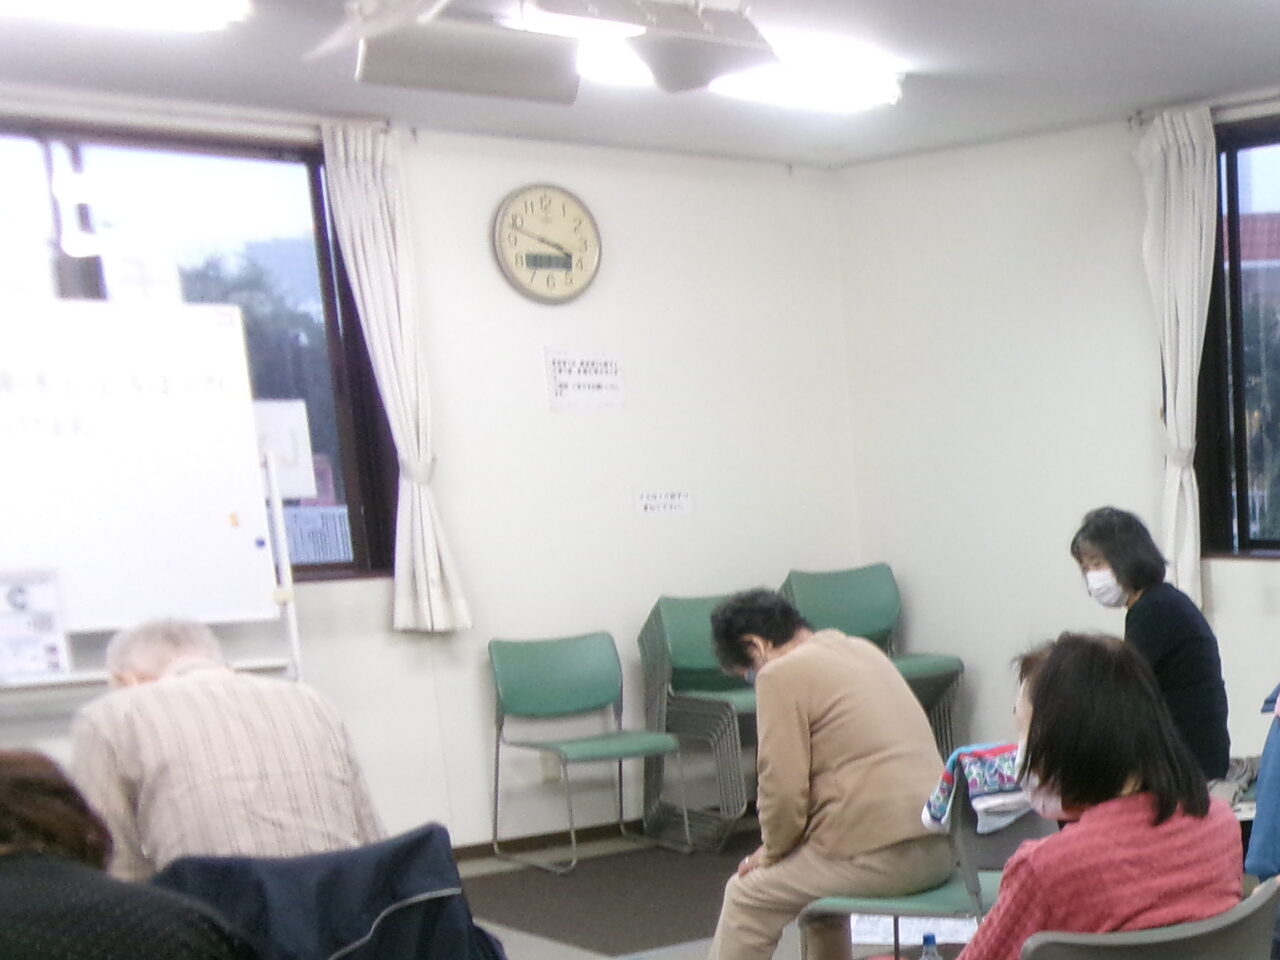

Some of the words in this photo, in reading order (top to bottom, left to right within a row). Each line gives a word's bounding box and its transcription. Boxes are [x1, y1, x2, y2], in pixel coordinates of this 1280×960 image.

[524, 201, 534, 215] 11
[539, 193, 552, 211] 12
[511, 213, 523, 229] 10
[574, 217, 582, 233] 2
[508, 232, 517, 246] 9
[580, 237, 588, 253] 3
[514, 253, 524, 267] 8
[576, 256, 584, 270] 4
[546, 272, 555, 289] 6
[565, 271, 574, 286] 5
